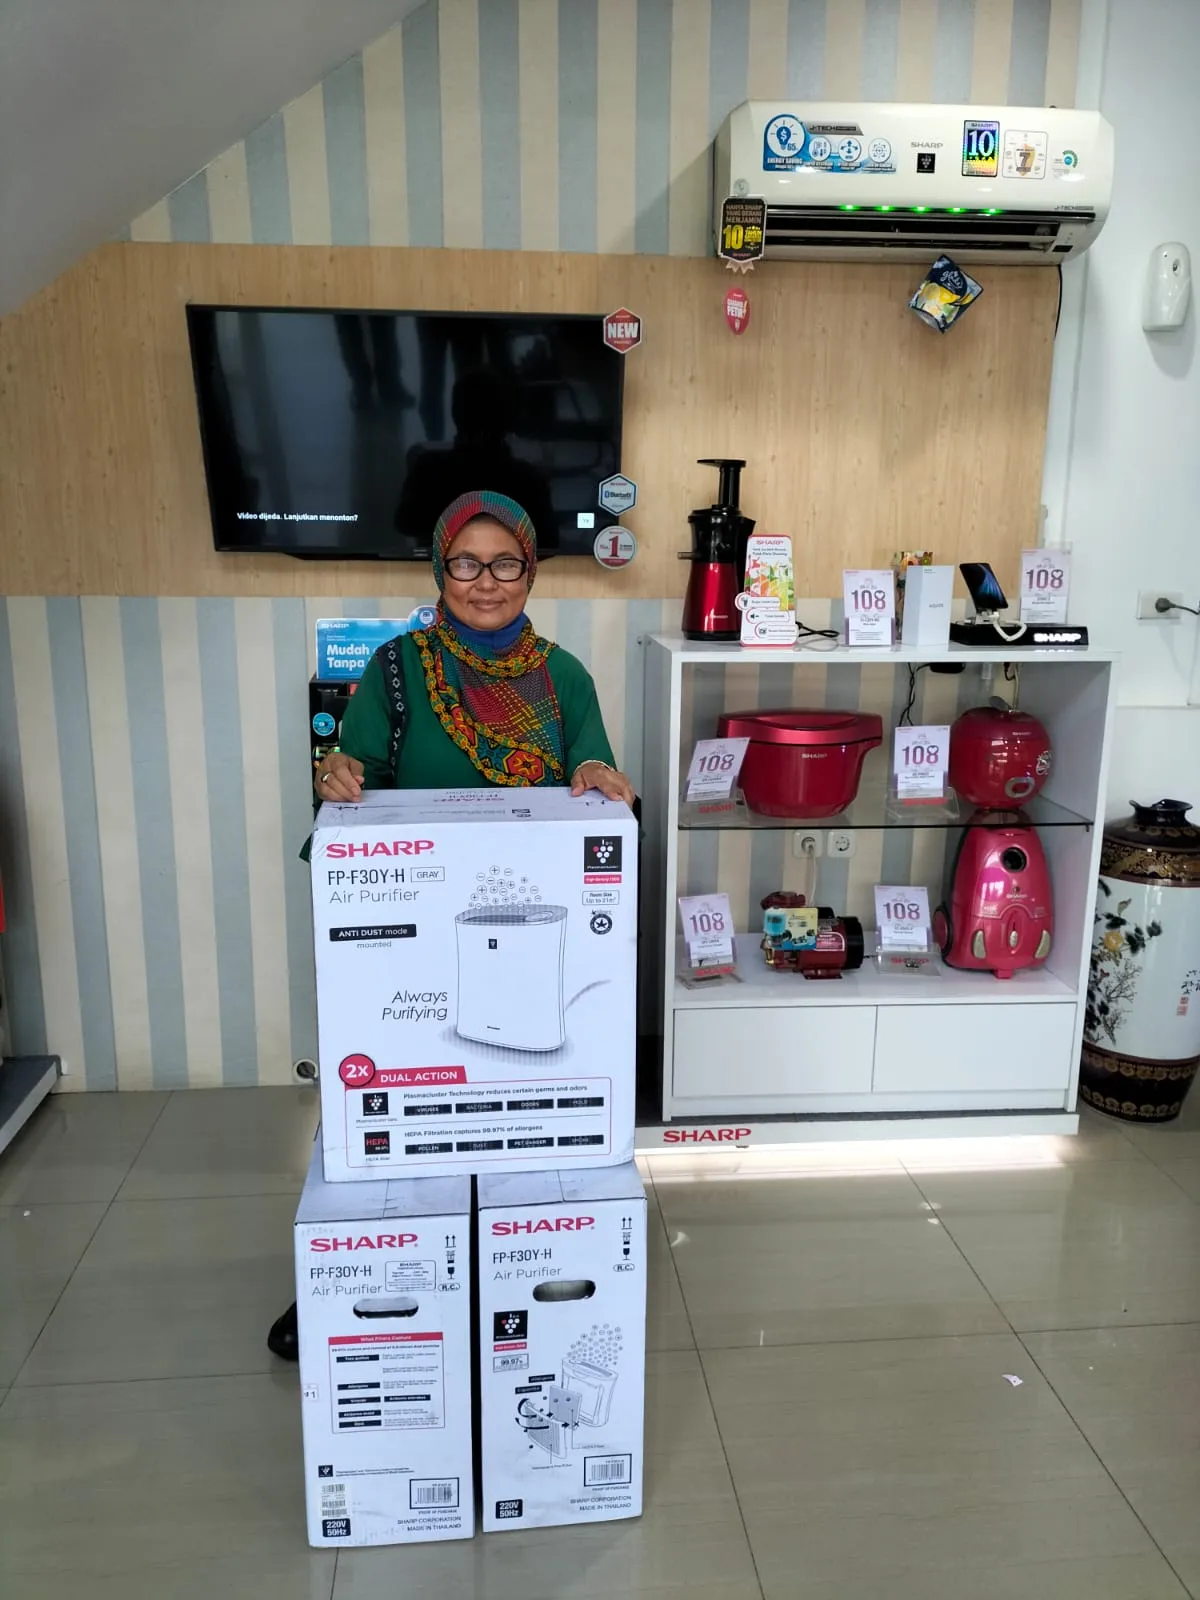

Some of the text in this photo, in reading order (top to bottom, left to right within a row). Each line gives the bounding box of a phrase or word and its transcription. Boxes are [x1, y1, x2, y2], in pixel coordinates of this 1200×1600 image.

[968, 131, 994, 157] 10
[1019, 152, 1031, 166] 7
[723, 225, 744, 250] 10
[608, 322, 639, 338] NEW
[237, 512, 257, 520] Video
[259, 512, 282, 521] dijeda.
[284, 513, 318, 522] Lanjutkan
[609, 535, 620, 557] 1
[1026, 569, 1064, 589] 108
[852, 590, 886, 610] 108
[1033, 633, 1081, 642] SHARP
[327, 644, 369, 656] Mudah
[327, 657, 365, 671] Tanpa
[902, 745, 939, 766] 108
[699, 754, 734, 773] 108
[326, 840, 435, 859] SHARP
[327, 868, 439, 886] FP-F30Y-H GRAY
[329, 888, 420, 904] Air Purifier
[883, 902, 920, 920] 108
[689, 912, 724, 935] 108
[338, 928, 408, 938] ANTI DUST mode
[356, 941, 392, 949] mounted
[391, 989, 448, 1003] Always
[382, 1005, 448, 1022] Purifying
[380, 1071, 457, 1083] DUAL ACTION
[403, 1091, 447, 1099] Plasmacluster
[448, 1090, 485, 1098] Technology
[454, 1128, 481, 1136] captures
[663, 1128, 752, 1143] SHARP
[366, 1138, 388, 1146] HEPA
[491, 1216, 595, 1236] SHARP
[310, 1233, 418, 1252] SHARP
[493, 1247, 552, 1264] FP-F30Y-H
[310, 1265, 372, 1279] FP-F30Y-H
[493, 1266, 562, 1281] Air Purifier
[311, 1284, 383, 1297] Air Purifier
[499, 1501, 519, 1510] 220V
[418, 1516, 461, 1524] CORPORATION
[499, 1509, 520, 1518] 50Hz
[326, 1520, 346, 1529] 220V
[327, 1528, 347, 1536] 50Hz
